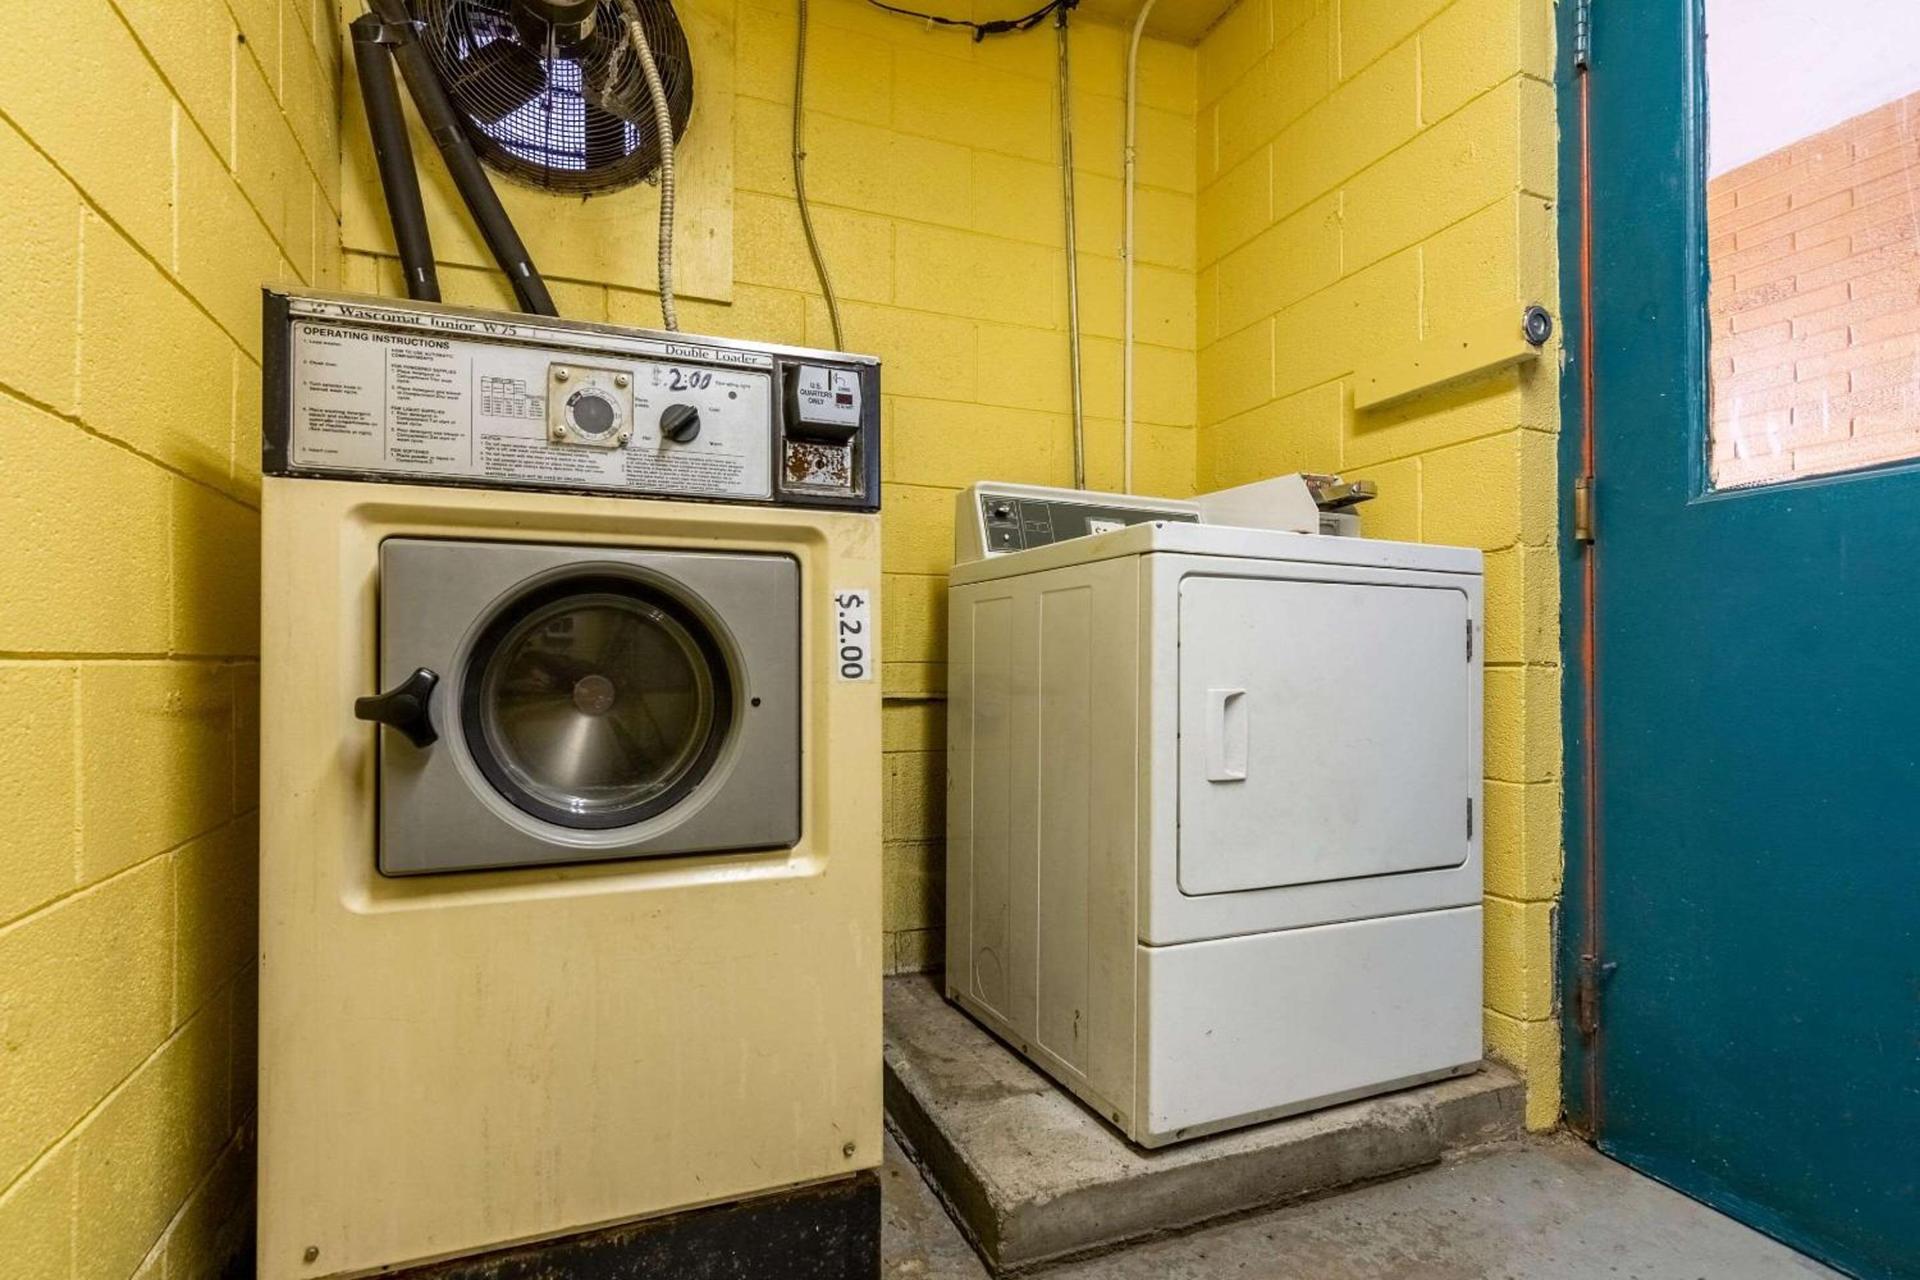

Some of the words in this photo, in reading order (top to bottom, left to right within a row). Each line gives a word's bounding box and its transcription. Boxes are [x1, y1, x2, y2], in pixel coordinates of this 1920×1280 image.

[338, 304, 420, 324] Wascomat
[430, 316, 476, 331] Junior
[303, 326, 369, 341] OPERATING
[371, 333, 450, 350] INSTRUCTIONS
[665, 343, 709, 359] Double
[715, 350, 758, 364] Loader
[669, 367, 713, 392] 2:00
[800, 388, 832, 398] QUARTERS
[807, 397, 824, 405] ONLY
[834, 594, 864, 679] $.2.00
